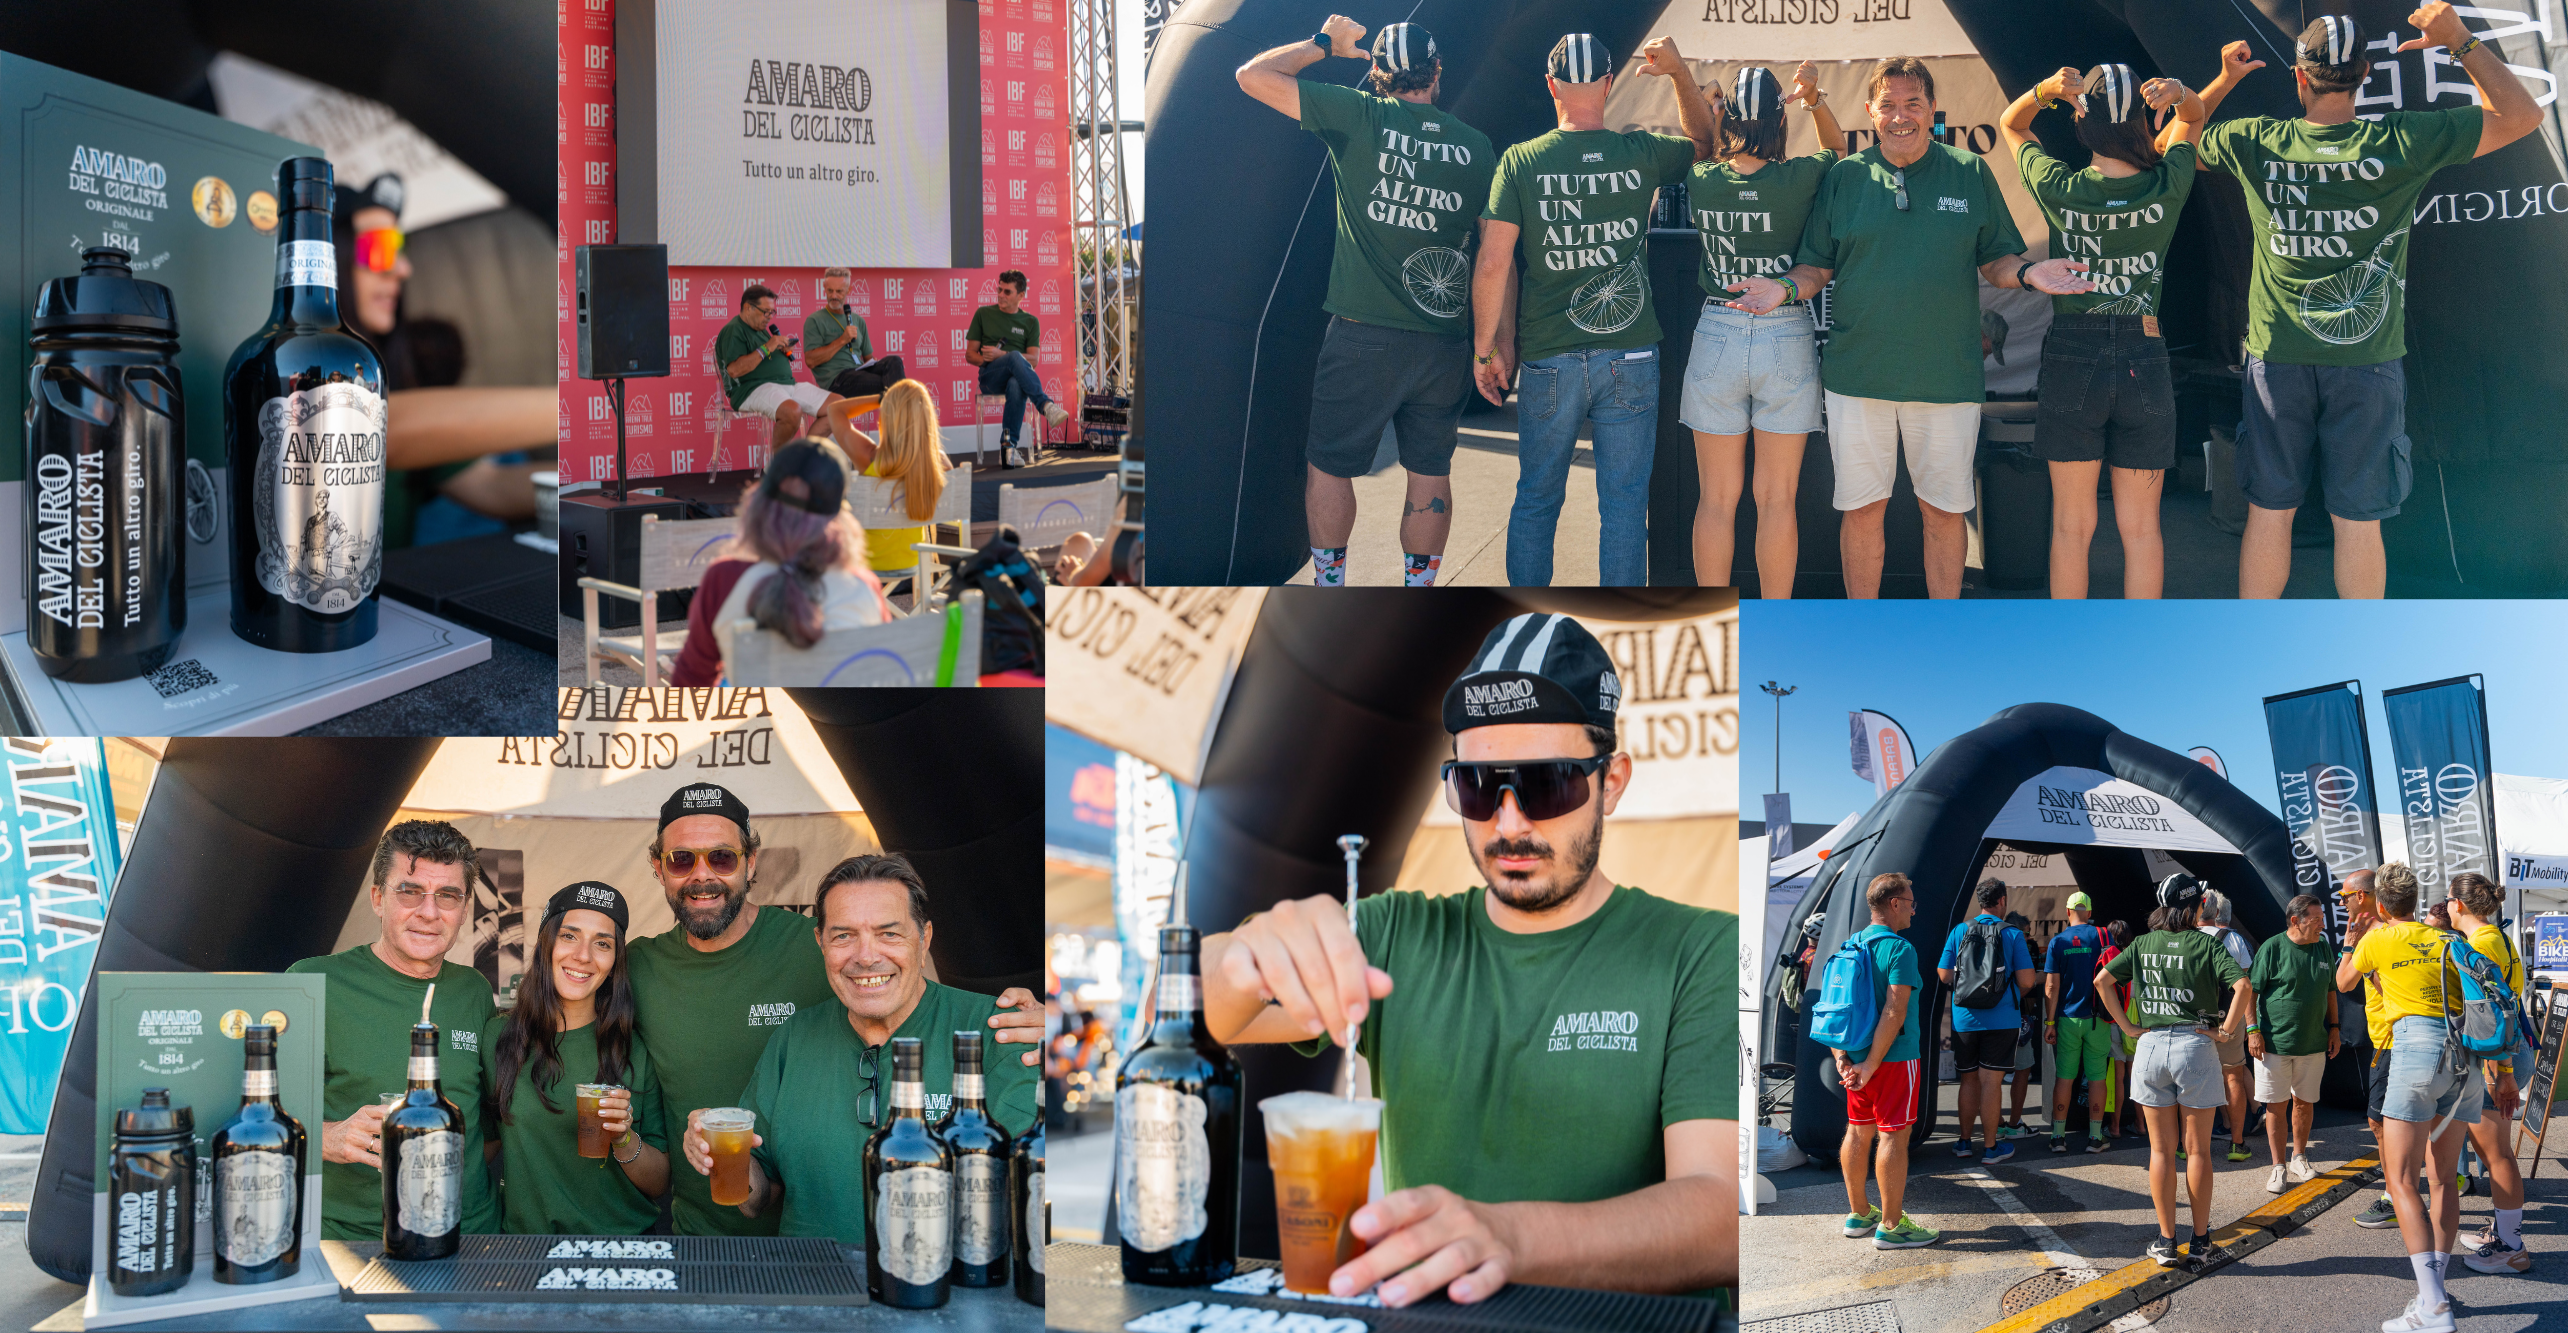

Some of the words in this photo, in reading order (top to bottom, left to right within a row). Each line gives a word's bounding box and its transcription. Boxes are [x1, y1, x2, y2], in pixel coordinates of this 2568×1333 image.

[1007, 32, 1024, 52] IBF
[585, 44, 609, 69] IBF
[744, 59, 872, 112] AMARO
[1007, 81, 1026, 101] IBF
[585, 103, 609, 128] IBF
[743, 110, 782, 139] DEL
[791, 113, 875, 145] CICLISTA
[1008, 130, 1026, 150] IBF
[1383, 128, 1471, 165] TUTTO
[70, 145, 167, 189] AMARO
[585, 161, 609, 186] IBF
[743, 160, 782, 178] Tutto
[787, 164, 804, 179] un
[809, 163, 843, 181] altro
[847, 164, 879, 186] giro.
[1378, 151, 1417, 180] UN
[2263, 157, 2384, 183] TUTTO
[69, 173, 99, 195] DEL
[105, 181, 168, 209] CICLISTA
[1009, 180, 1027, 199] IBF
[1370, 177, 1463, 212] ALTRO
[1536, 169, 1642, 196] TUTTO
[2264, 181, 2309, 206] UN
[85, 199, 154, 221] ORIGINALE
[1367, 200, 1438, 233] GIRO.
[1538, 199, 1583, 222] UN
[2060, 203, 2164, 232] TUTTO
[2268, 206, 2379, 233] ALTRO
[102, 231, 140, 254] 1814
[586, 220, 609, 244] IBF
[1011, 229, 1028, 249] IBF
[1542, 217, 1638, 246] ALTRO
[1701, 231, 1736, 255] UN
[2061, 231, 2102, 256] UN
[1545, 245, 1618, 271] GIRO.
[2270, 233, 2353, 258] GIRO.
[884, 278, 904, 299] IBF
[950, 278, 968, 299] IBF
[283, 432, 381, 463] AMARO
[124, 444, 144, 489] giro.
[281, 466, 315, 486] DEL
[323, 465, 381, 485] CICLISTA
[76, 450, 104, 568] CICLISTA
[125, 495, 141, 540] altro
[38, 453, 72, 627] AMARO
[128, 545, 141, 570] un
[77, 577, 104, 629] DEL
[124, 575, 141, 627] Tutto
[327, 598, 345, 608] 1814
[1464, 678, 1534, 704] AMARO
[1466, 704, 1486, 716] DEL
[1489, 696, 1540, 716] CICLISTA
[684, 788, 722, 801] AMARO
[2038, 785, 2160, 816] AMARO
[2041, 808, 2080, 825] DEL
[2087, 813, 2175, 833] CICLISTA
[2509, 858, 2534, 881] BIT
[2531, 866, 2568, 883] Mobility
[578, 886, 615, 901] AMARO
[2538, 946, 2568, 957] BIKE
[2142, 969, 2161, 984] UN
[2140, 986, 2194, 1003] ALTRO
[139, 1010, 202, 1026] AMARO
[749, 1002, 796, 1018] AMARO
[2141, 1001, 2185, 1016] GIRO.
[138, 1026, 157, 1036] DEL
[160, 1026, 203, 1036] CICLISTA
[748, 1017, 762, 1026] DEL
[1550, 1011, 1639, 1036] AMARO
[148, 1037, 193, 1045] ORIGINALE
[1547, 1036, 1572, 1052] DEL
[1577, 1035, 1638, 1052] CICLISTA
[158, 1053, 184, 1065] 1814
[412, 1152, 459, 1169] AMARO
[226, 1174, 285, 1192] AMARO
[891, 1190, 946, 1207] AMARO
[141, 1189, 158, 1245] CICLISTA
[117, 1192, 142, 1273] AMARO
[547, 1250, 583, 1259] DEL
[591, 1250, 675, 1259] CICLISTA
[549, 1240, 673, 1252] AMARO
[140, 1246, 156, 1273] DEL
[536, 1280, 578, 1290] DEL
[585, 1280, 678, 1290] CICLISTA
[540, 1267, 676, 1281] AMARO
